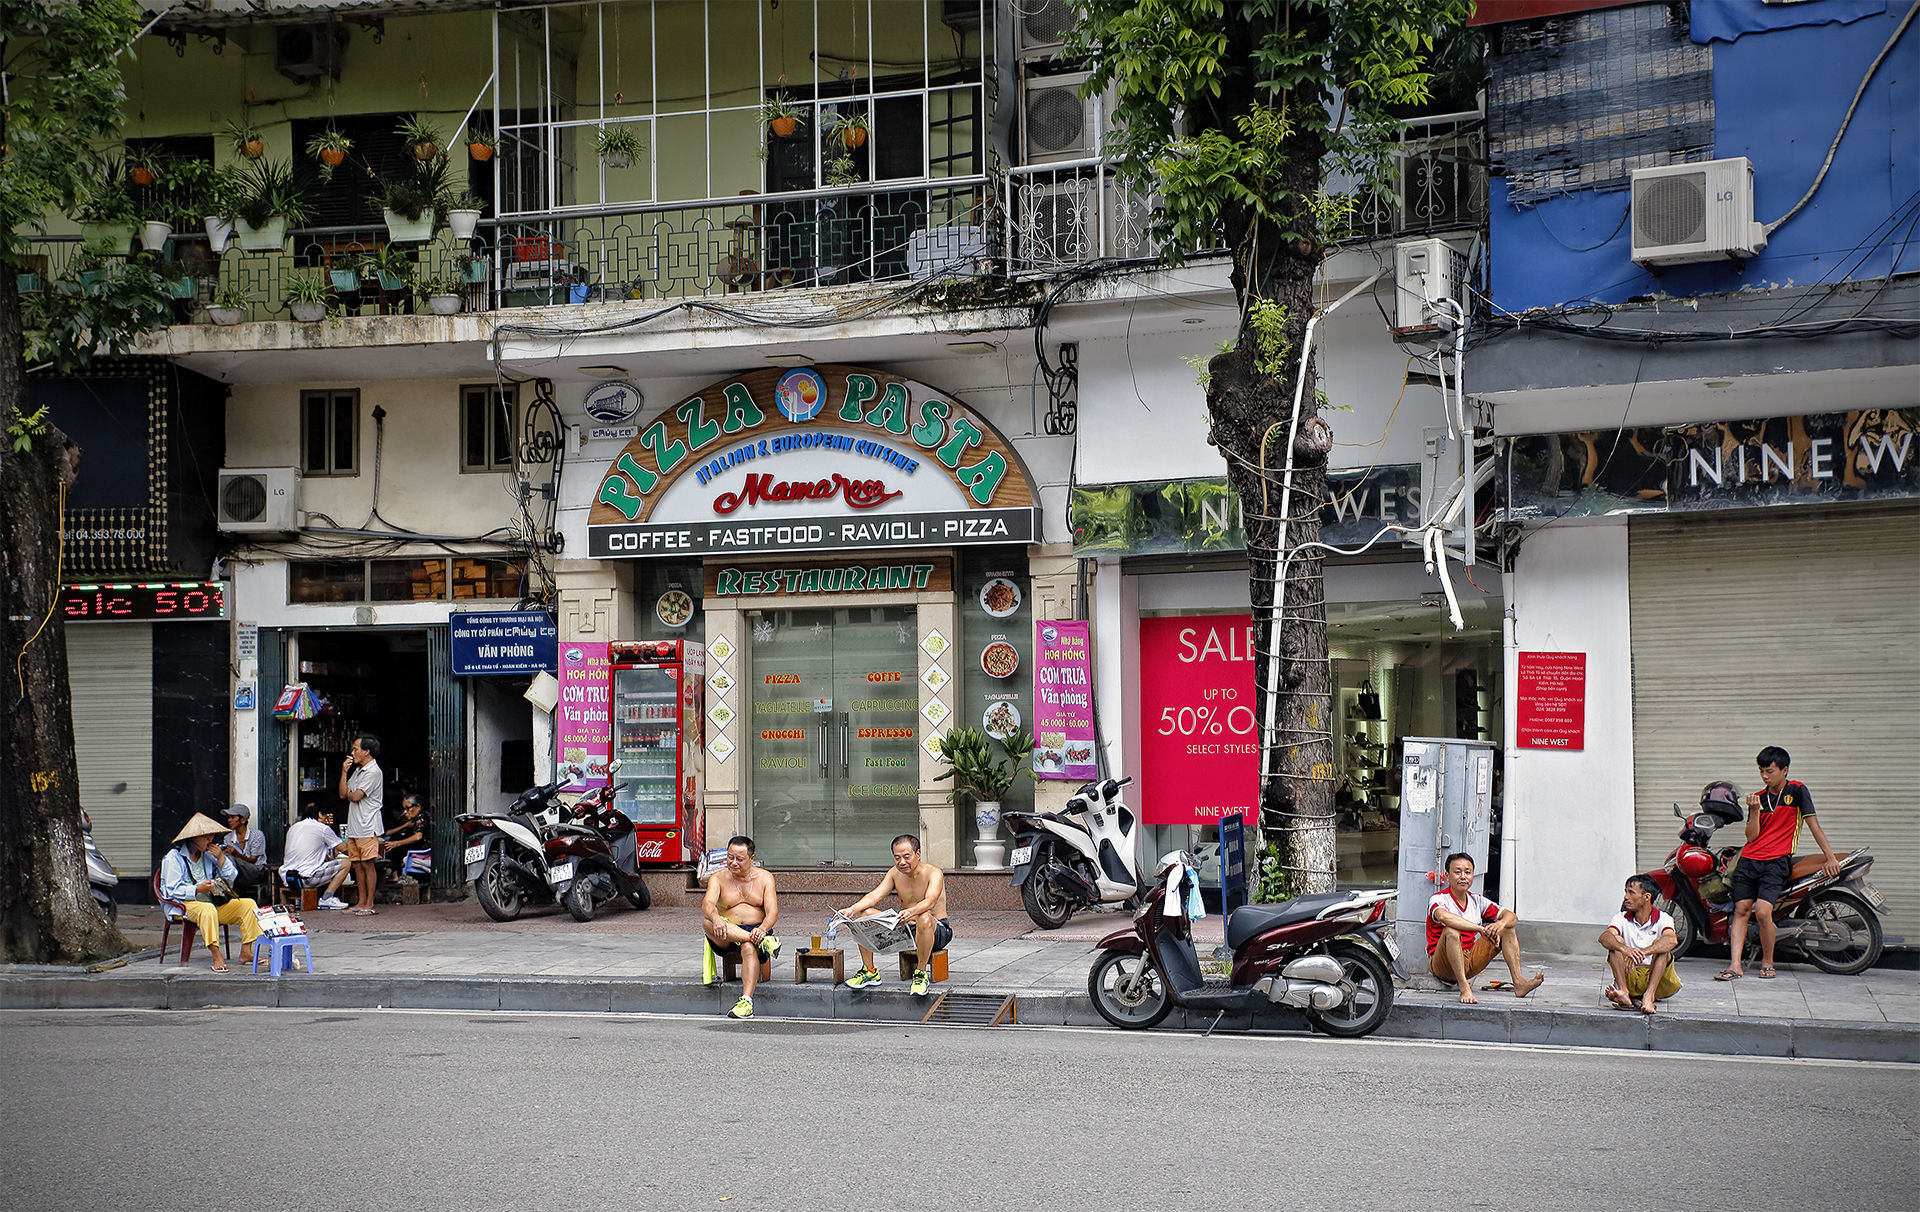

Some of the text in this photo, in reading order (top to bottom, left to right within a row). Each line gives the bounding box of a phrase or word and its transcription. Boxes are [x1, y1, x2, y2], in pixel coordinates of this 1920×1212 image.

[1717, 191, 1733, 202] LG
[598, 373, 1008, 521] PIZZA PASTA
[695, 433, 920, 485] ITALIAN & EUROPEAN CUISINE
[1690, 438, 1833, 486] NINE
[273, 488, 284, 496] LG
[1201, 486, 1421, 531] NI WES
[608, 518, 1009, 550] COFFEE FASTFOOD RAVIOLI PIZZA
[716, 565, 934, 596] RESTAURANT
[454, 628, 470, 638] CÔNG
[471, 629, 478, 637] TY
[479, 627, 487, 637] CỔ
[1061, 637, 1071, 645] Nhà
[1072, 637, 1083, 646] hàng
[1177, 626, 1255, 663] SALE
[478, 643, 533, 658] VĂN PHÒNG
[1044, 647, 1085, 660] HOA HỒNG
[587, 657, 599, 666] Nhà
[567, 667, 609, 680] HOA HỒN
[765, 674, 801, 684] PIZZA
[867, 672, 901, 683] COFFE
[1040, 666, 1087, 685] CƠM TRƯA
[563, 685, 609, 702] CƠM TRƯ
[1041, 688, 1087, 708] Văn phòng
[1203, 688, 1237, 700] UP TO
[755, 701, 812, 714] TAGLIATELLE
[563, 705, 608, 724] Văn phòn
[1158, 705, 1223, 736] 50%
[592, 735, 609, 743] 60.00
[761, 729, 806, 740] GNOCCHI
[857, 728, 914, 739] ESPRESSO
[1531, 737, 1569, 746] NINE WEST
[1186, 743, 1257, 754] SELECT STYLES
[760, 757, 807, 769] RAVIOLI
[864, 758, 906, 768] Fast Food
[848, 785, 919, 797] ICE CREAM
[1194, 806, 1250, 817] NINE WEST
